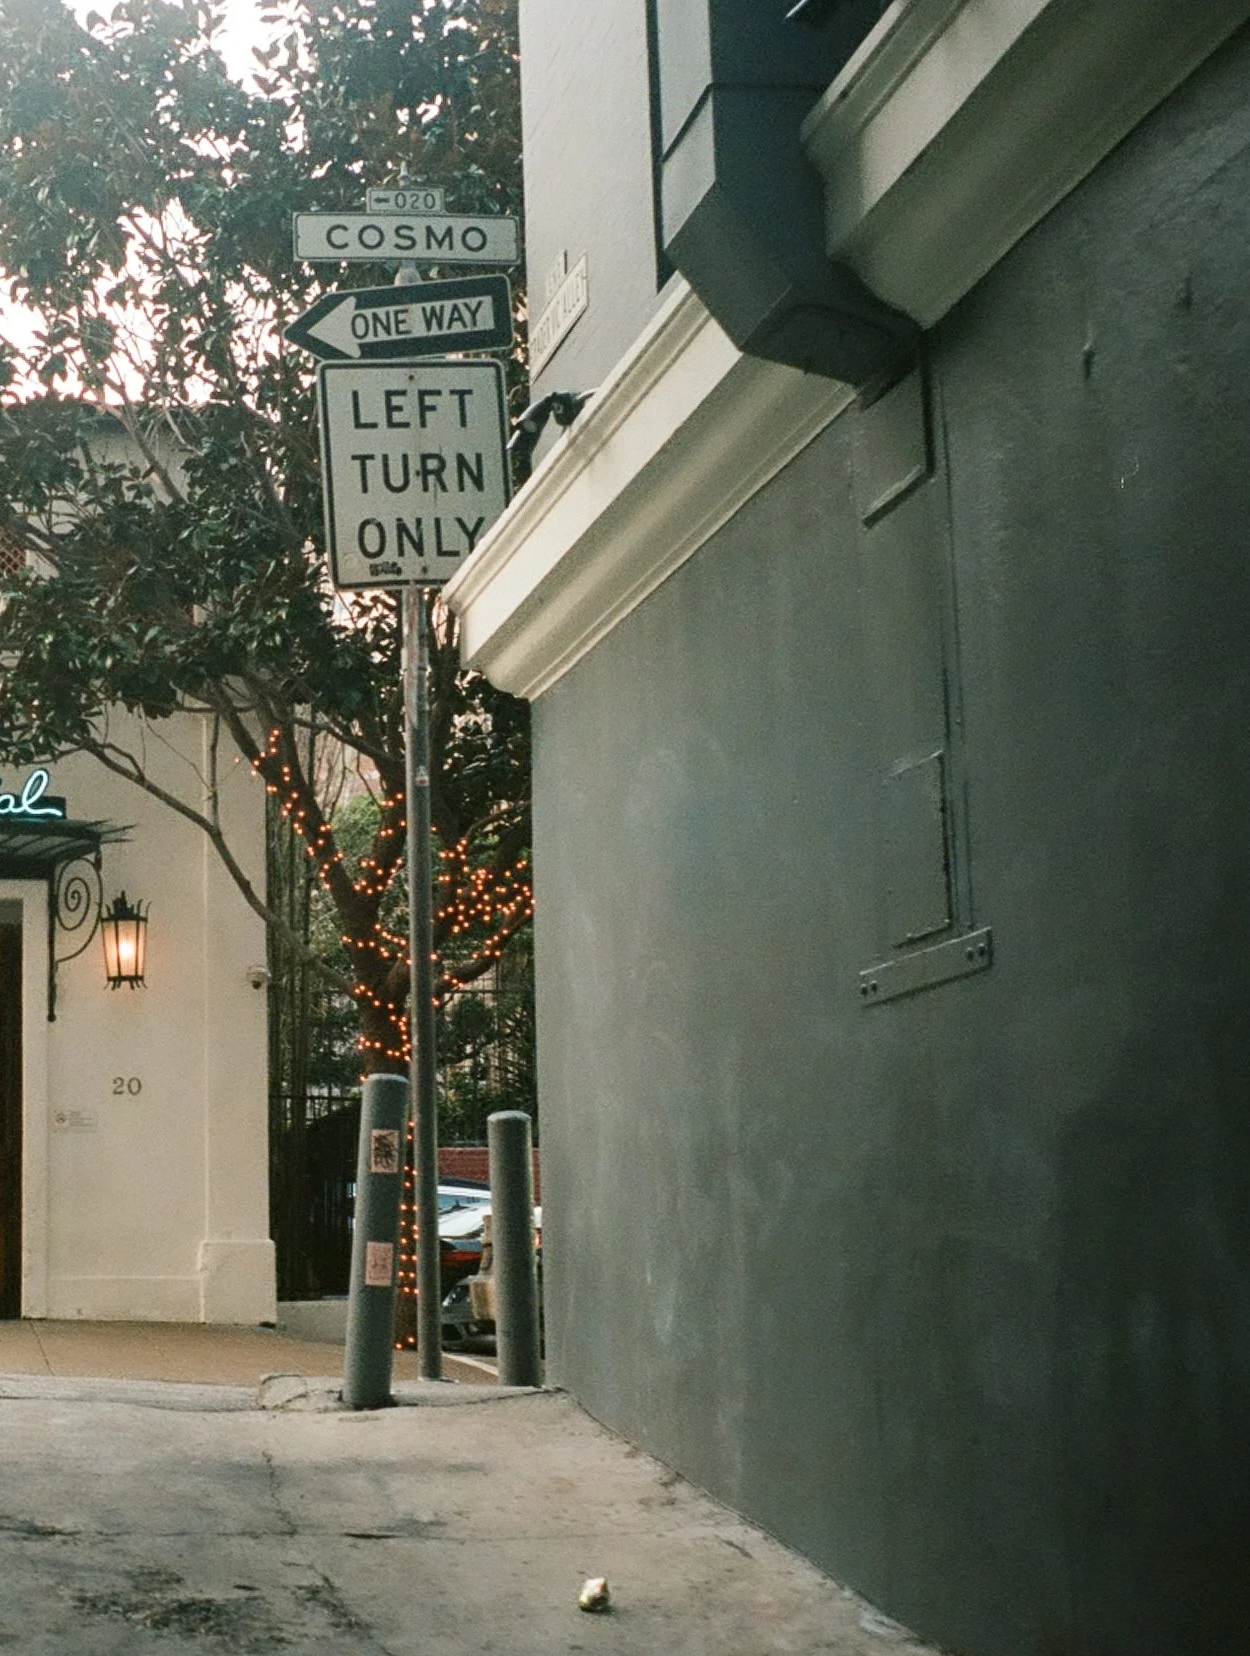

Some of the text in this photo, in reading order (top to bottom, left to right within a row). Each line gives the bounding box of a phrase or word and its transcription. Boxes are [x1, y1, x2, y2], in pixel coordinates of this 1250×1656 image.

[394, 192, 436, 209] 020
[325, 224, 488, 253] COSMO
[351, 299, 483, 340] ONE WAY
[352, 389, 474, 430] LEFT
[351, 453, 486, 494] TURN
[358, 516, 486, 560] ONLY
[112, 1076, 142, 1096] 20
